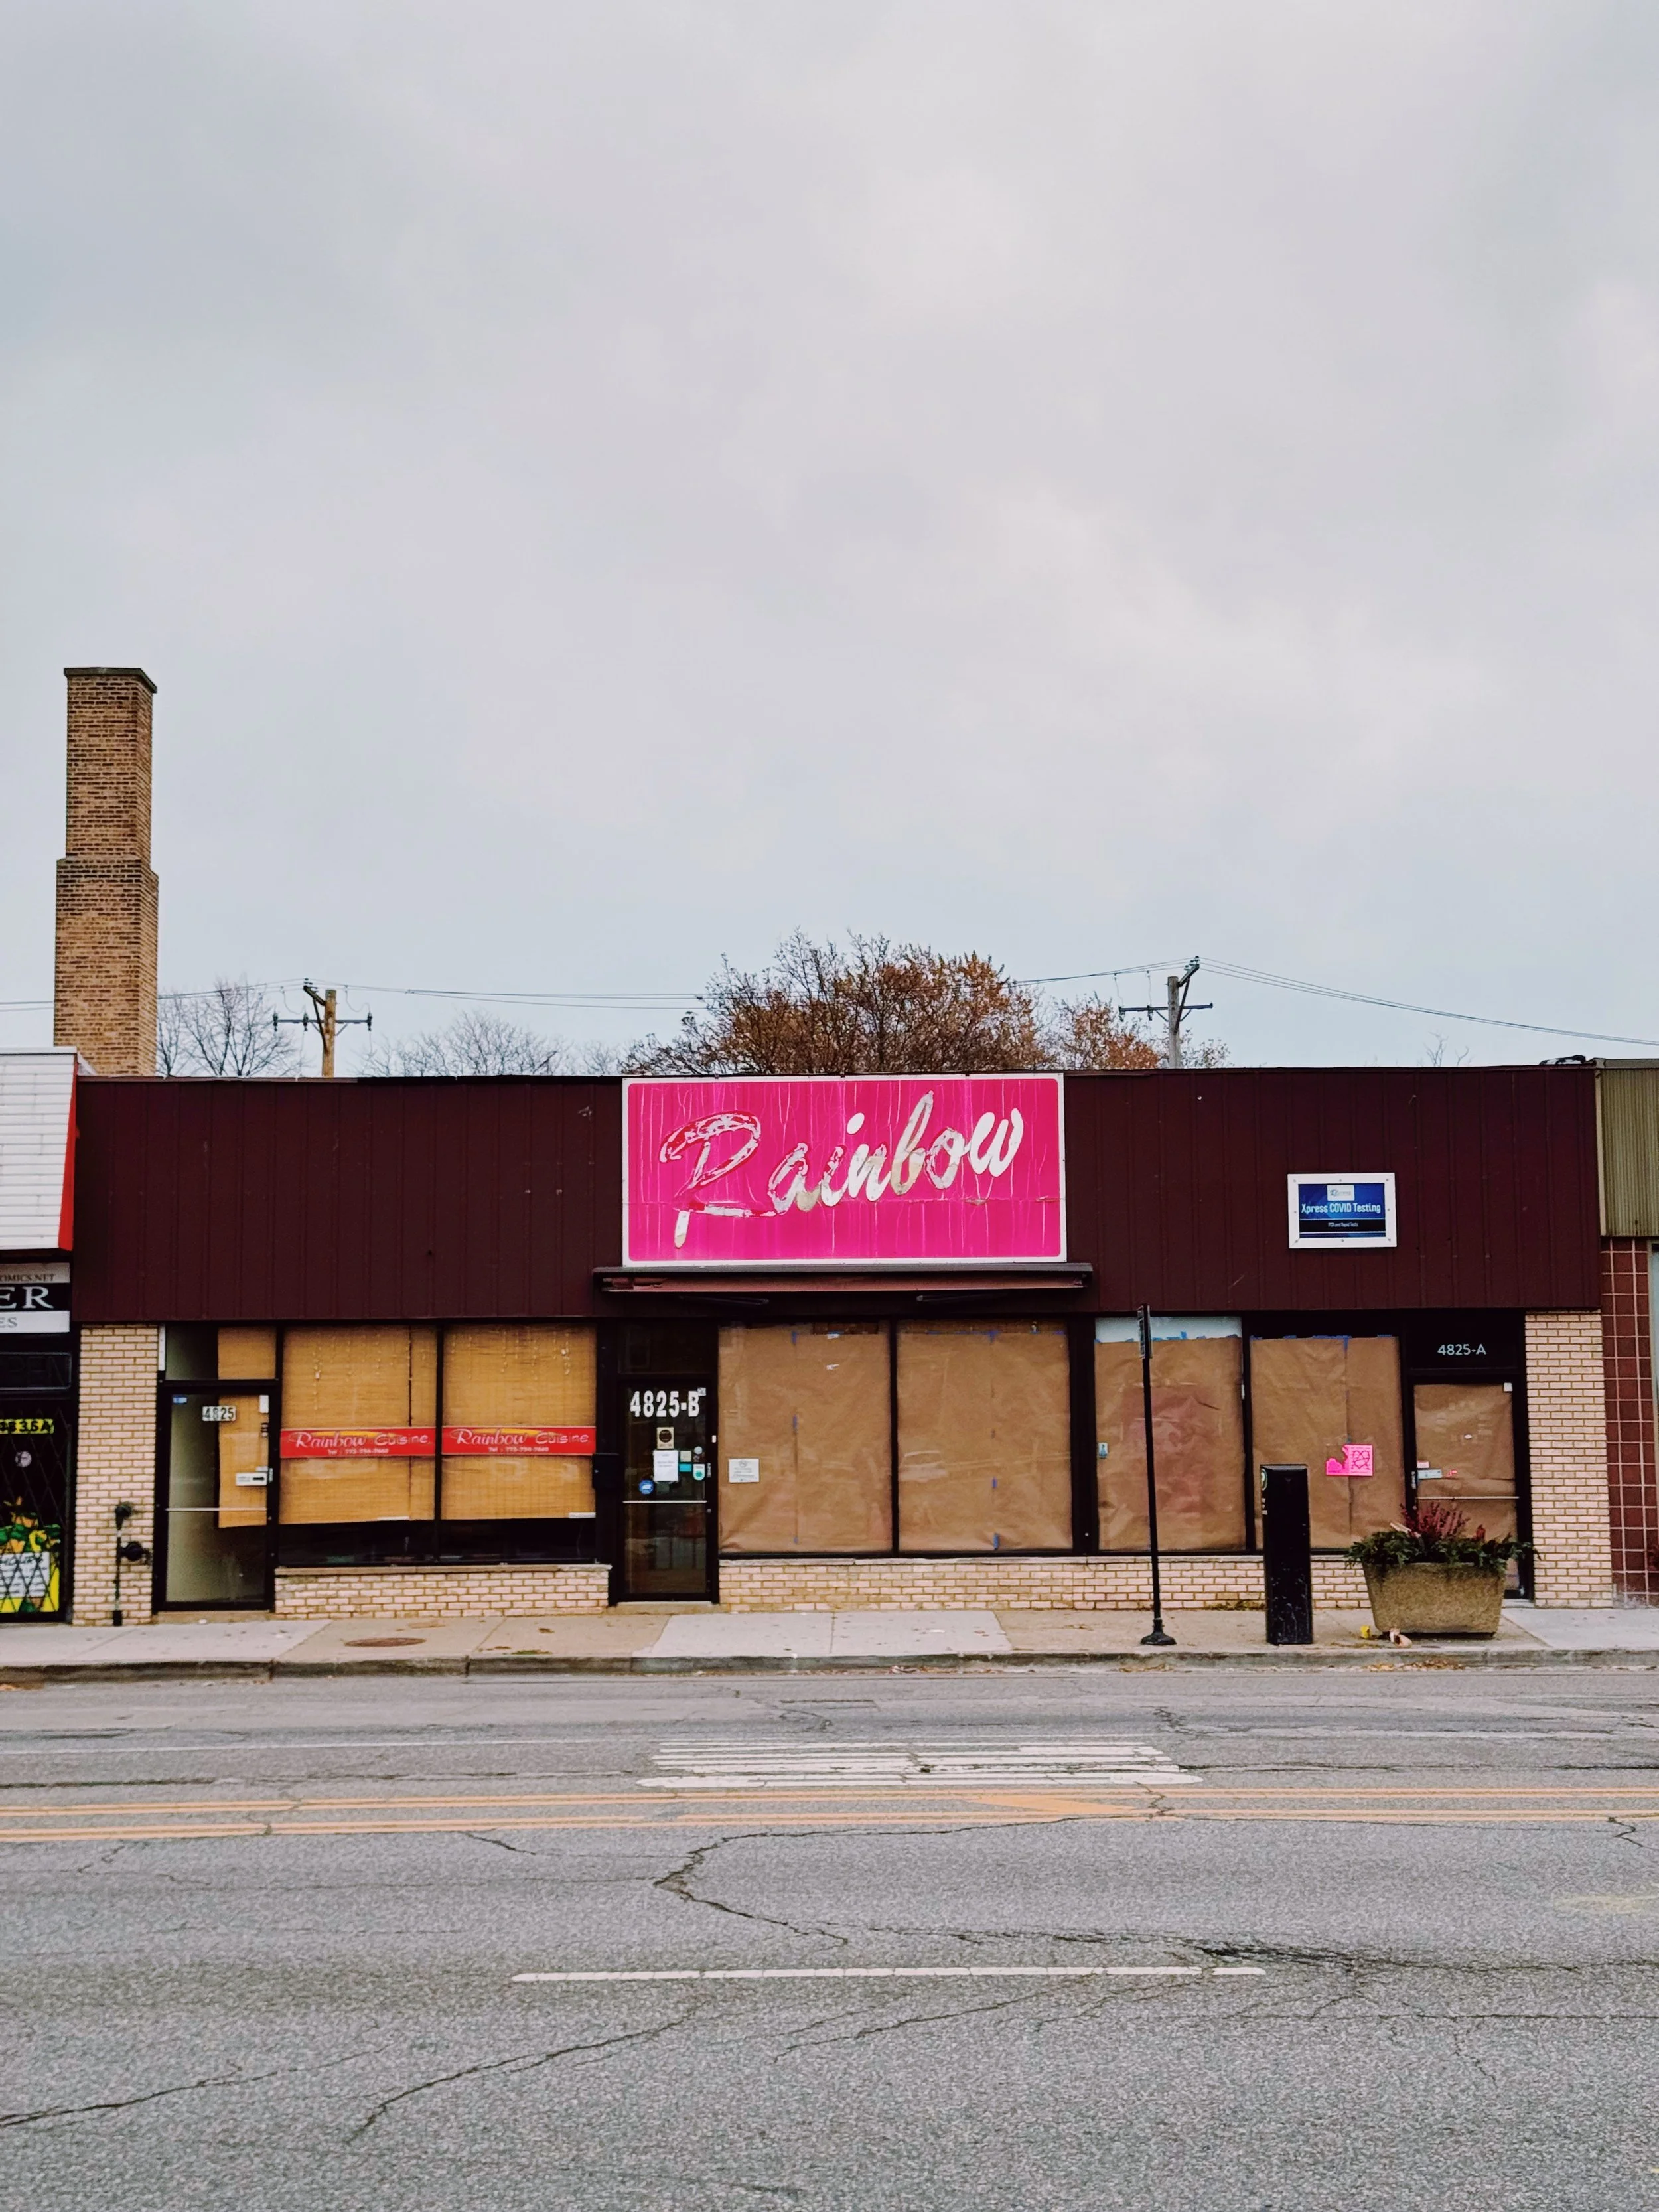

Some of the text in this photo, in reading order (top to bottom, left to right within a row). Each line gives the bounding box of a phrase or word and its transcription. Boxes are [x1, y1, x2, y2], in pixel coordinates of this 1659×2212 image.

[660, 1090, 1023, 1248] Rainbow
[1301, 1203, 1381, 1214] Xpress COVID Testing
[1437, 1343, 1487, 1355] 4825-A
[630, 1390, 699, 1418] 4825-B
[204, 1407, 234, 1420] 4825
[288, 1431, 429, 1447] Rainbow Cuisine
[449, 1428, 589, 1445] Rainbow Cuisine
